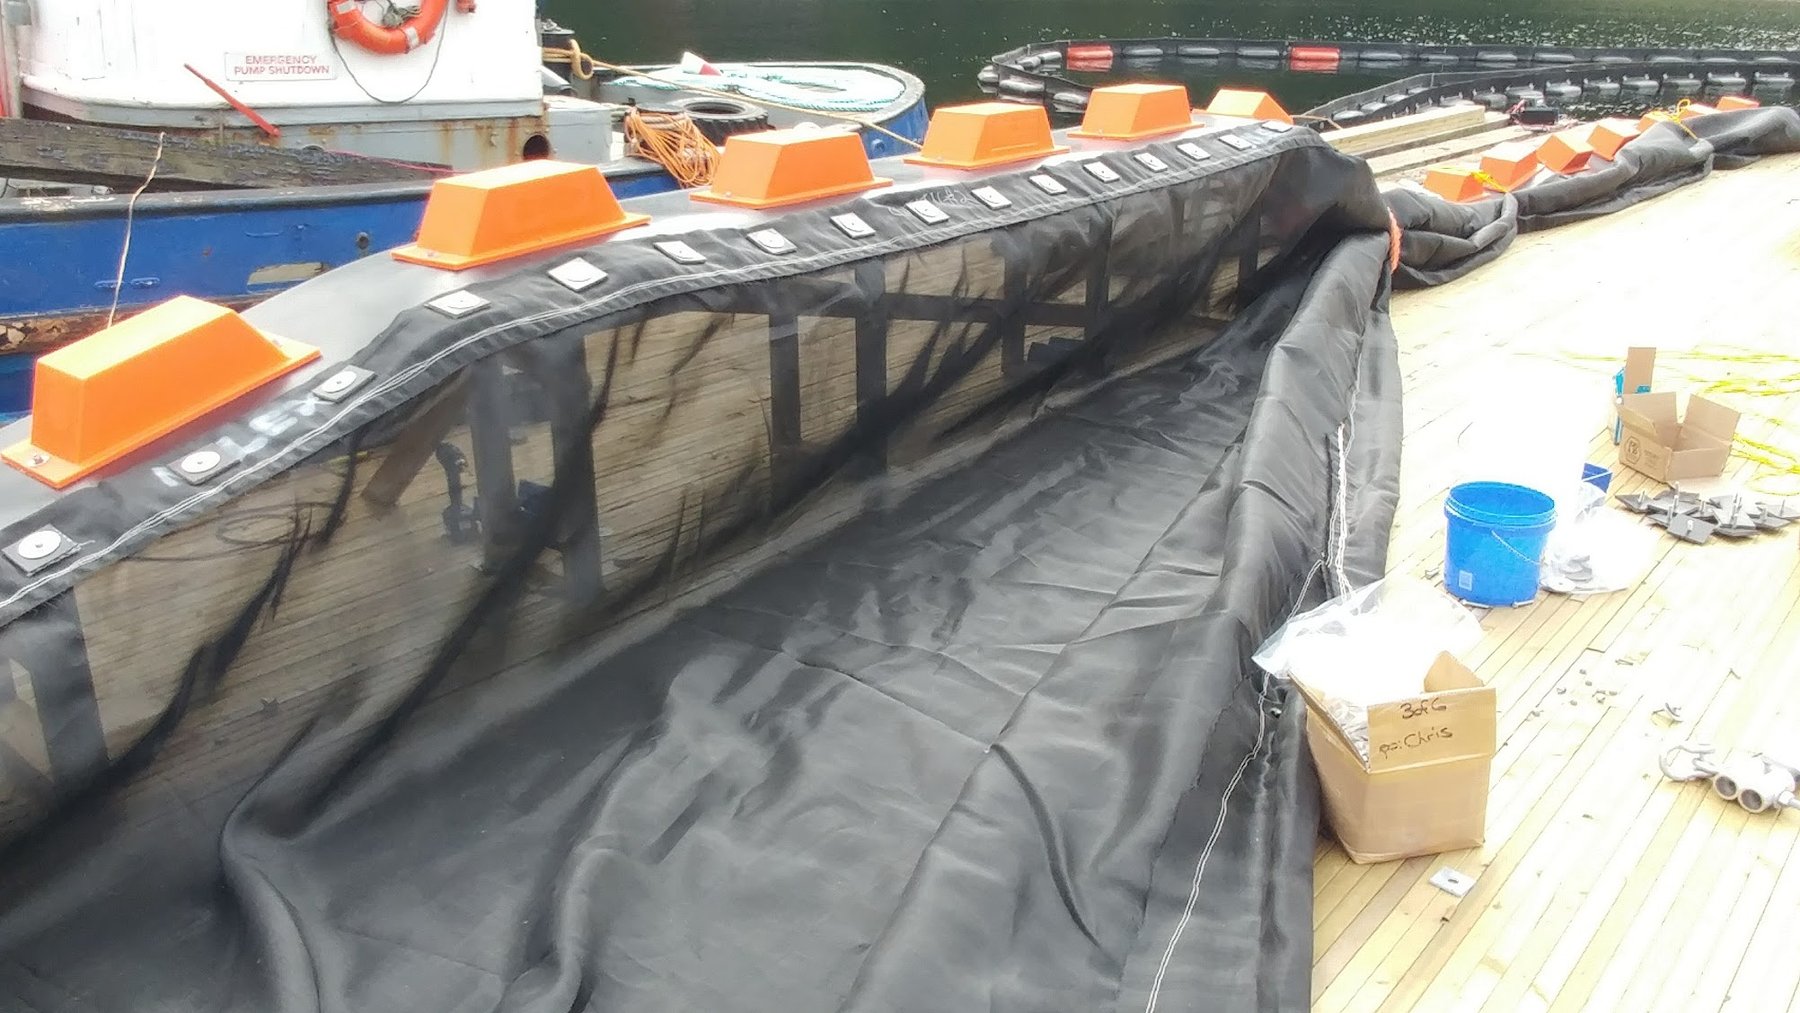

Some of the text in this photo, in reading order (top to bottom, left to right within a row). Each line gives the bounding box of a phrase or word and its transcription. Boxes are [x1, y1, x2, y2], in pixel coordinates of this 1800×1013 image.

[245, 55, 318, 65] EMERGENCY
[234, 65, 330, 76] PUMP SHUTDOWN
